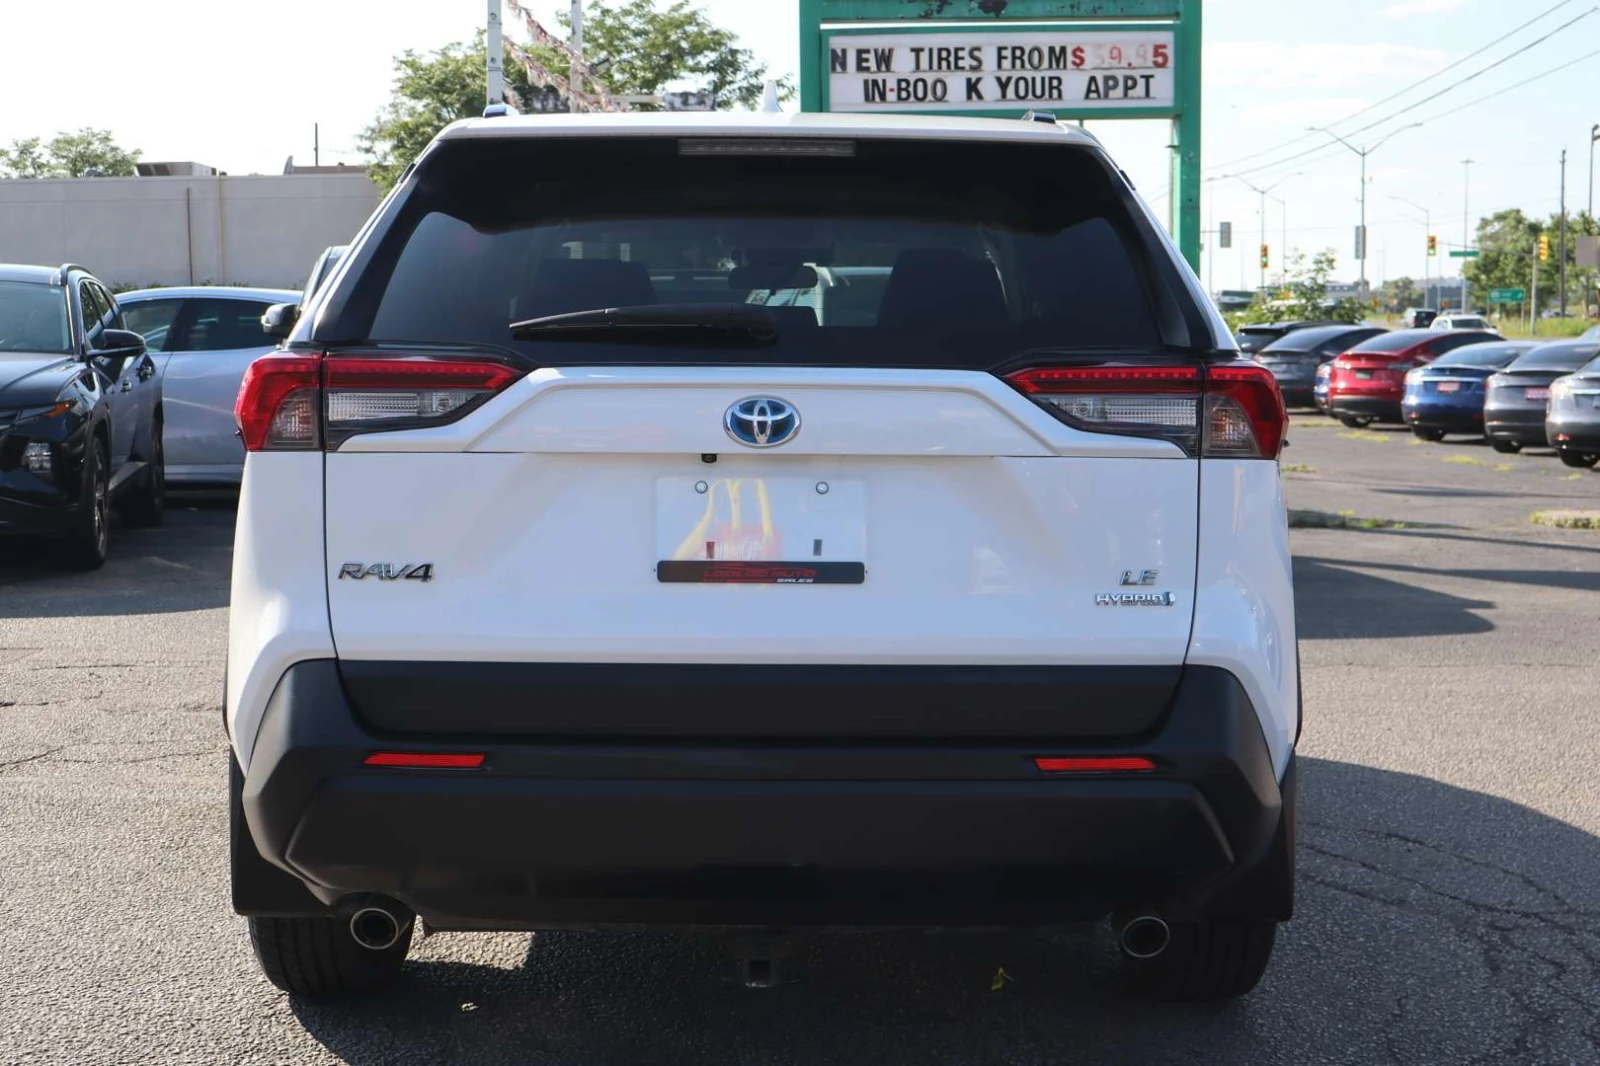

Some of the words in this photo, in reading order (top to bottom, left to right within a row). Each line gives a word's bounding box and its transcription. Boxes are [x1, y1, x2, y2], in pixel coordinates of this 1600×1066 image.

[910, 47, 983, 71] TIRES
[995, 76, 1063, 99] YOUR
[1084, 75, 1155, 99] APPT
[338, 563, 434, 582] RAV4
[1120, 569, 1158, 585] LE
[1095, 593, 1164, 606] HYBRID
